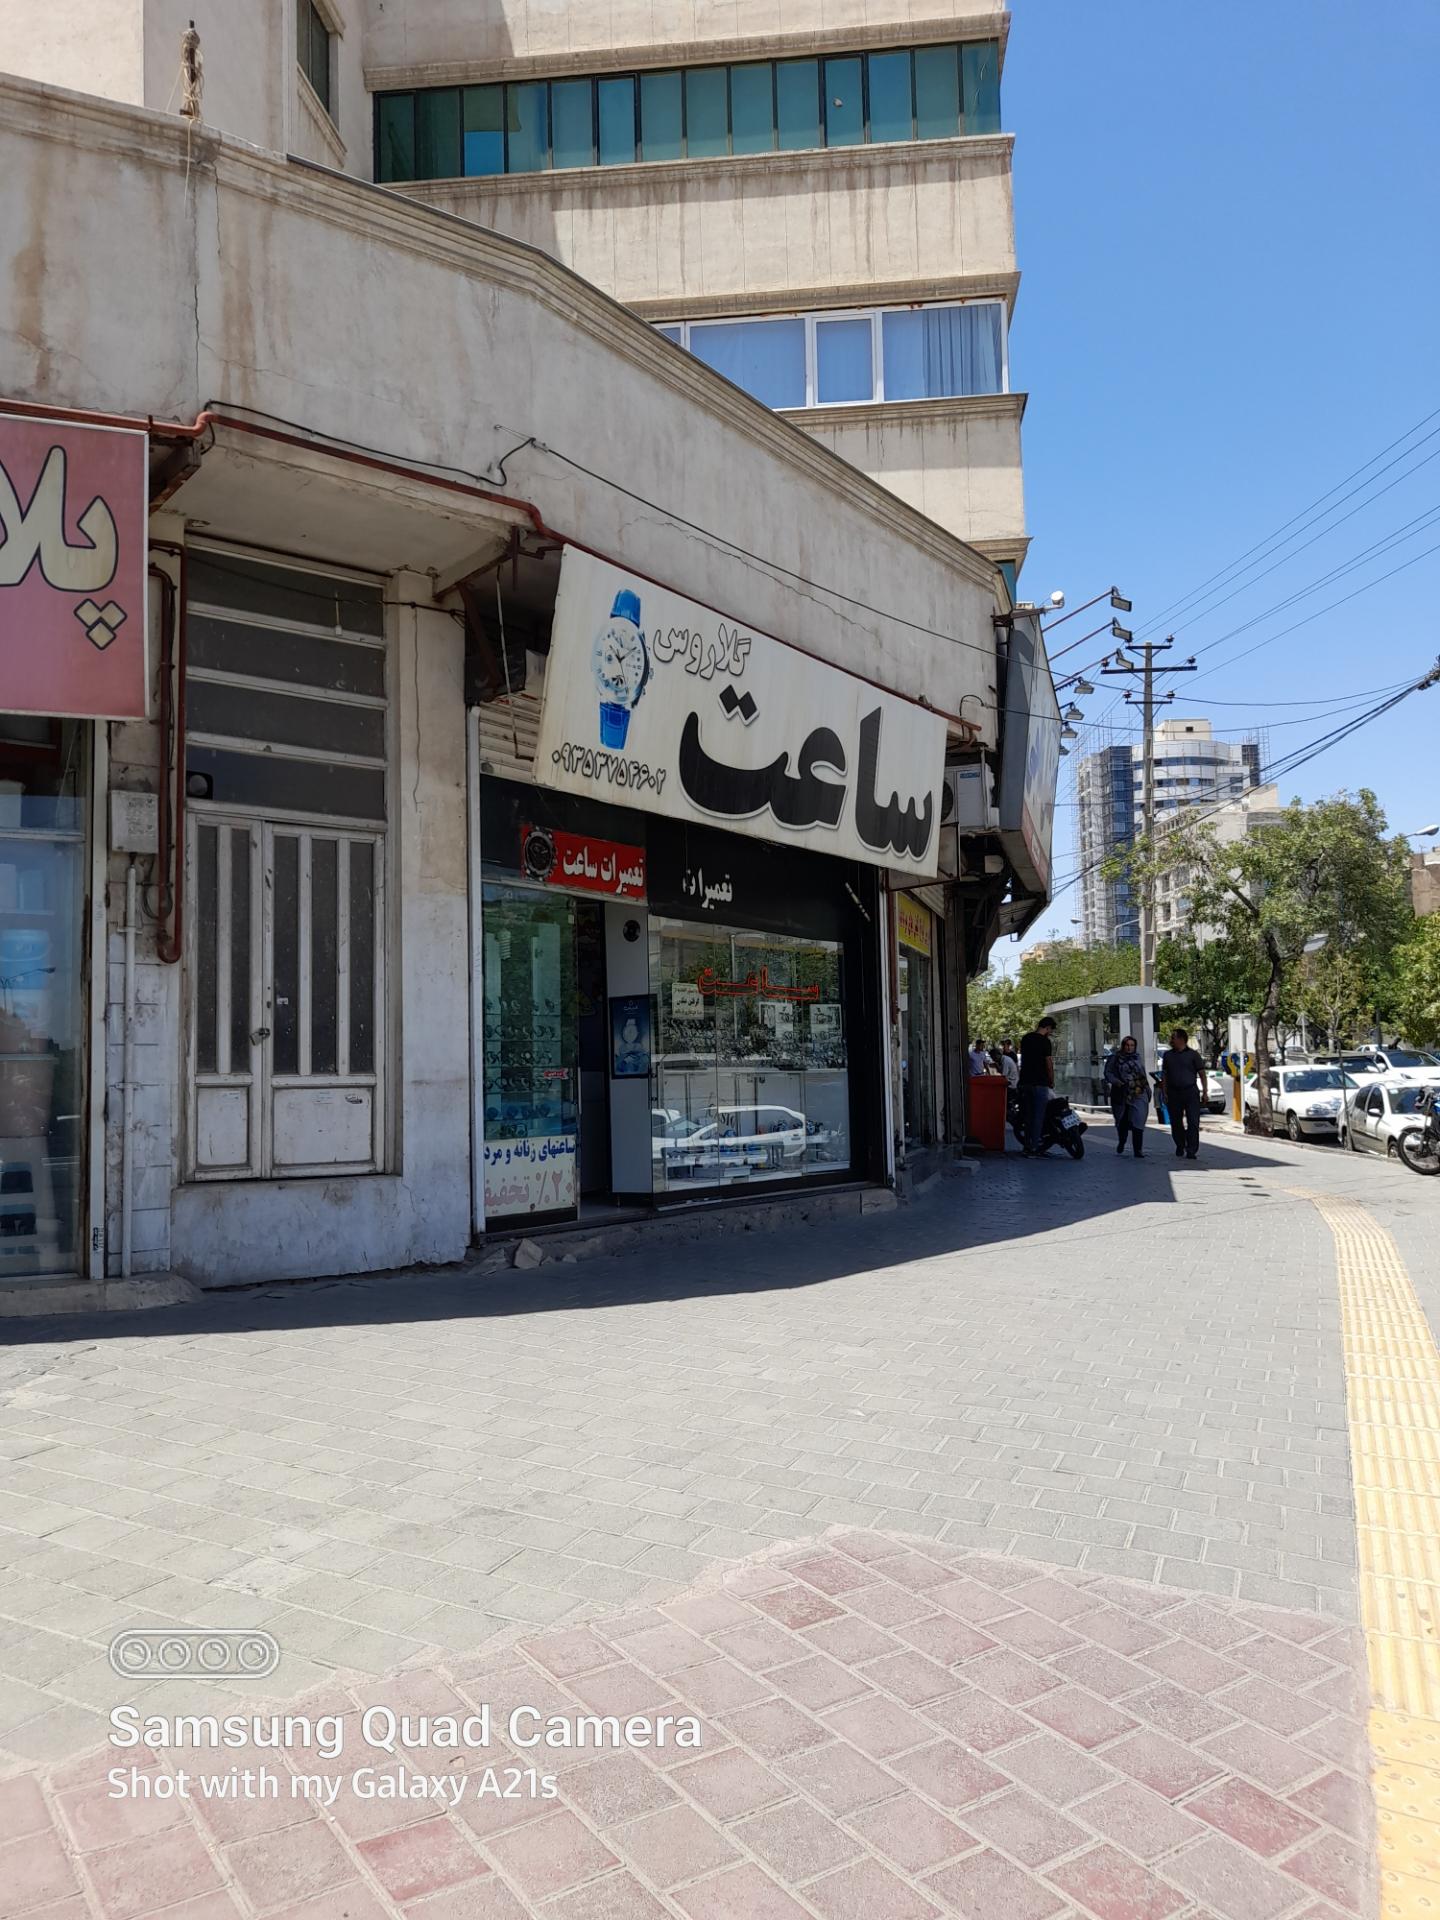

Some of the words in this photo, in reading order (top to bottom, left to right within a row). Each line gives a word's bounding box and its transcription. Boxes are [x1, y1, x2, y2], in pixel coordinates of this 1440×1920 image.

[653, 622, 752, 681] گلاروس
[551, 742, 667, 796] ۰۹۳۵۳۷۵۴۶۰۲
[679, 684, 933, 860] ساعت
[562, 846, 598, 880] ساعت
[601, 853, 645, 894] تعمیرات
[697, 966, 820, 1000] ساعت
[504, 1148, 511, 1165] و
[514, 1138, 536, 1163] زنانه
